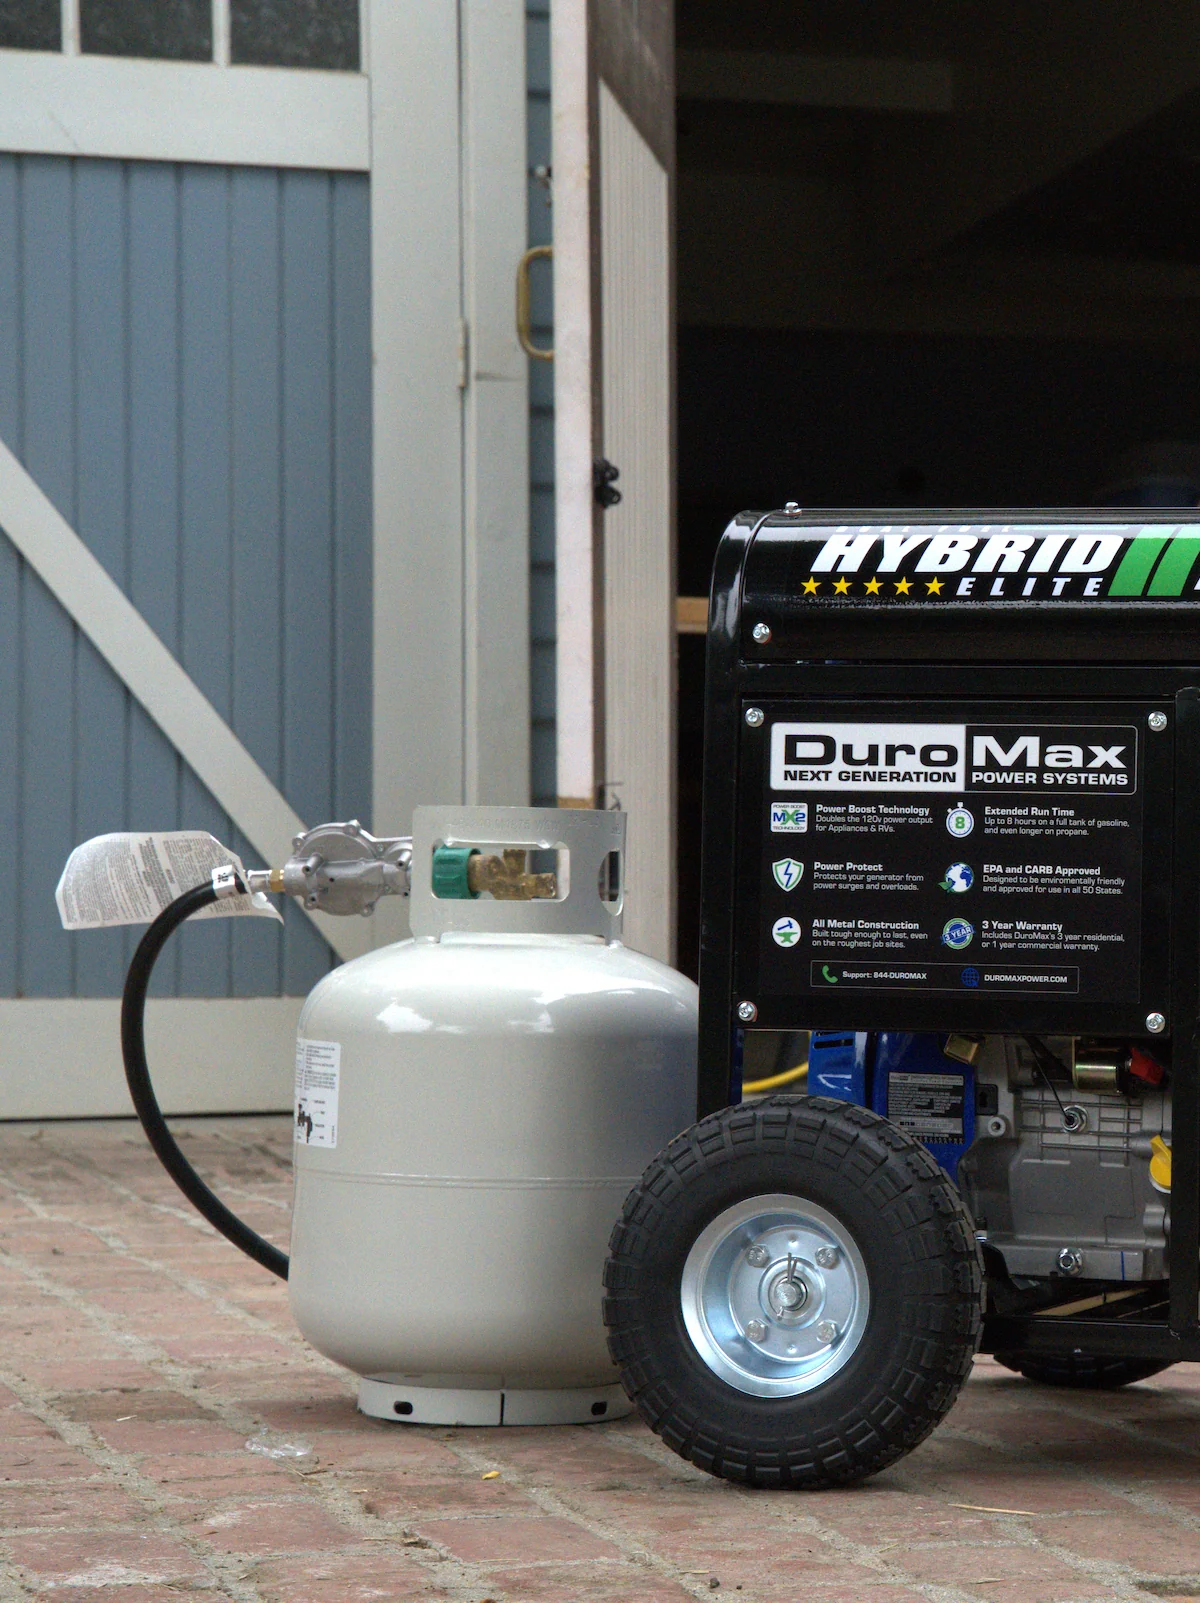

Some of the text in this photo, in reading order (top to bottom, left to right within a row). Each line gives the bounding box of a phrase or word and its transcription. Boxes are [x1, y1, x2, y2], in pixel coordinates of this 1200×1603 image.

[810, 534, 1124, 572] HYBRID
[956, 578, 1104, 596] ELITE
[784, 770, 956, 782] NEXT GENERATION
[972, 772, 1127, 785] POWER SYSTEMS
[816, 805, 930, 816] Power Boost Technology
[985, 807, 1074, 816] Extended Run Time
[908, 816, 932, 825] output
[955, 816, 965, 829] 8
[828, 824, 868, 834] Appliances
[1019, 827, 1043, 836] longer
[814, 862, 882, 871] Power Protect
[983, 865, 1100, 877] EPA and CARB Approved
[848, 874, 864, 882] your
[866, 874, 904, 883] generator
[982, 875, 1017, 885] Designed
[1040, 876, 1095, 886] enviromentally
[1096, 877, 1124, 887] friendly
[813, 883, 836, 891] power
[838, 884, 864, 892] surges
[998, 885, 1033, 895] approved
[812, 920, 918, 929] All Metal Construction
[982, 921, 1062, 933] 3 Year Warranty
[830, 930, 852, 939] tough
[854, 930, 881, 940] enough
[892, 931, 908, 939] last,
[951, 928, 972, 938] YEAR
[1064, 934, 1081, 942] year
[1083, 933, 1124, 942] residential,
[1063, 943, 1099, 952] warranty.
[842, 971, 926, 980] Support: 844-DUROMAX
[984, 974, 1067, 982] DUROMAXPOWER.COM
